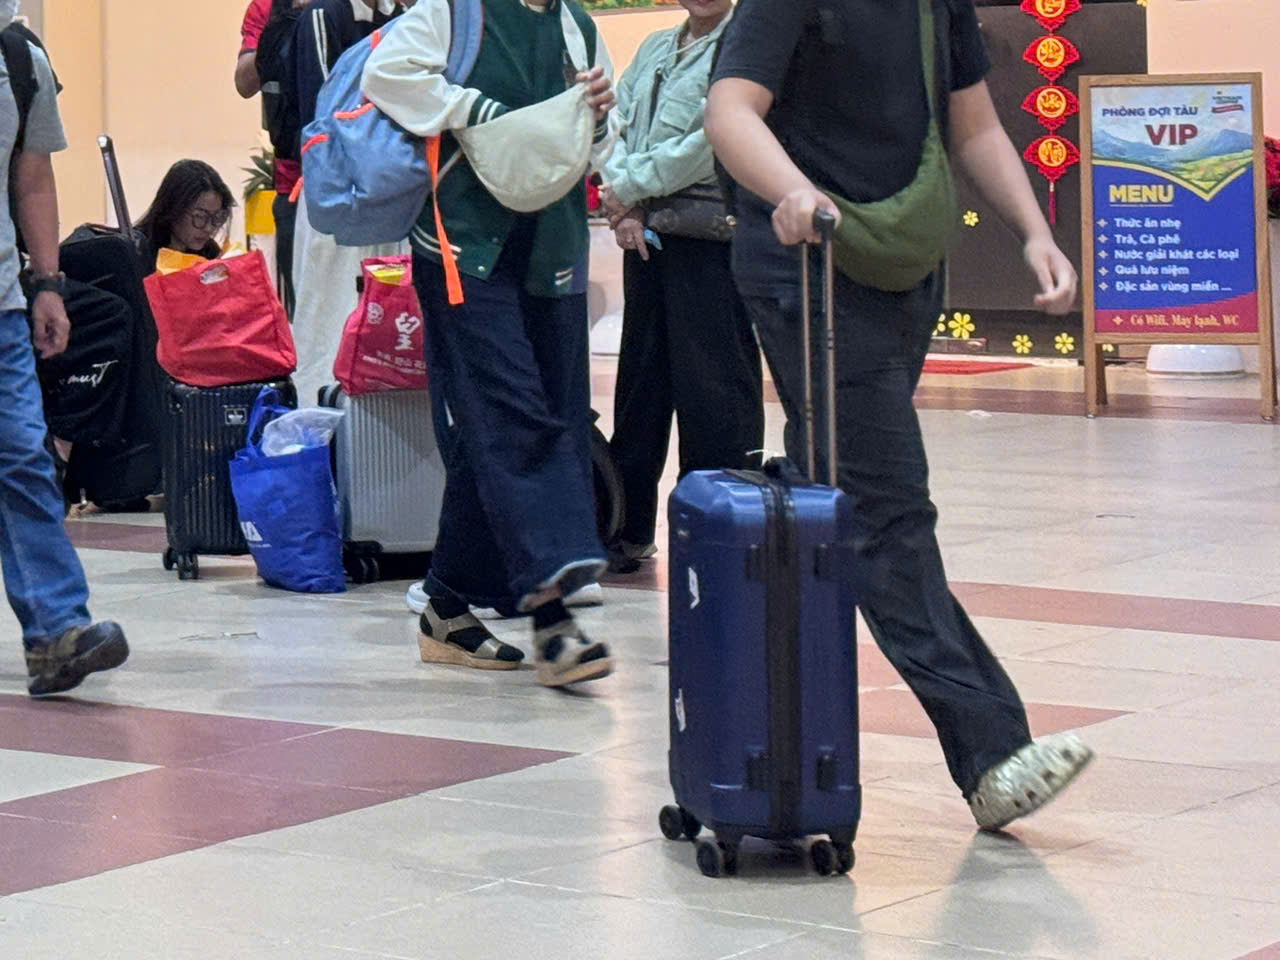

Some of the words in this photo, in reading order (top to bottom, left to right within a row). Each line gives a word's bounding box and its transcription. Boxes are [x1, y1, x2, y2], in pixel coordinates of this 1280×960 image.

[1102, 105, 1146, 117] PHÒNG
[1174, 104, 1199, 116] TÀU
[1144, 123, 1199, 146] VIP
[1108, 183, 1175, 203] MENU
[1222, 314, 1240, 326] WC
